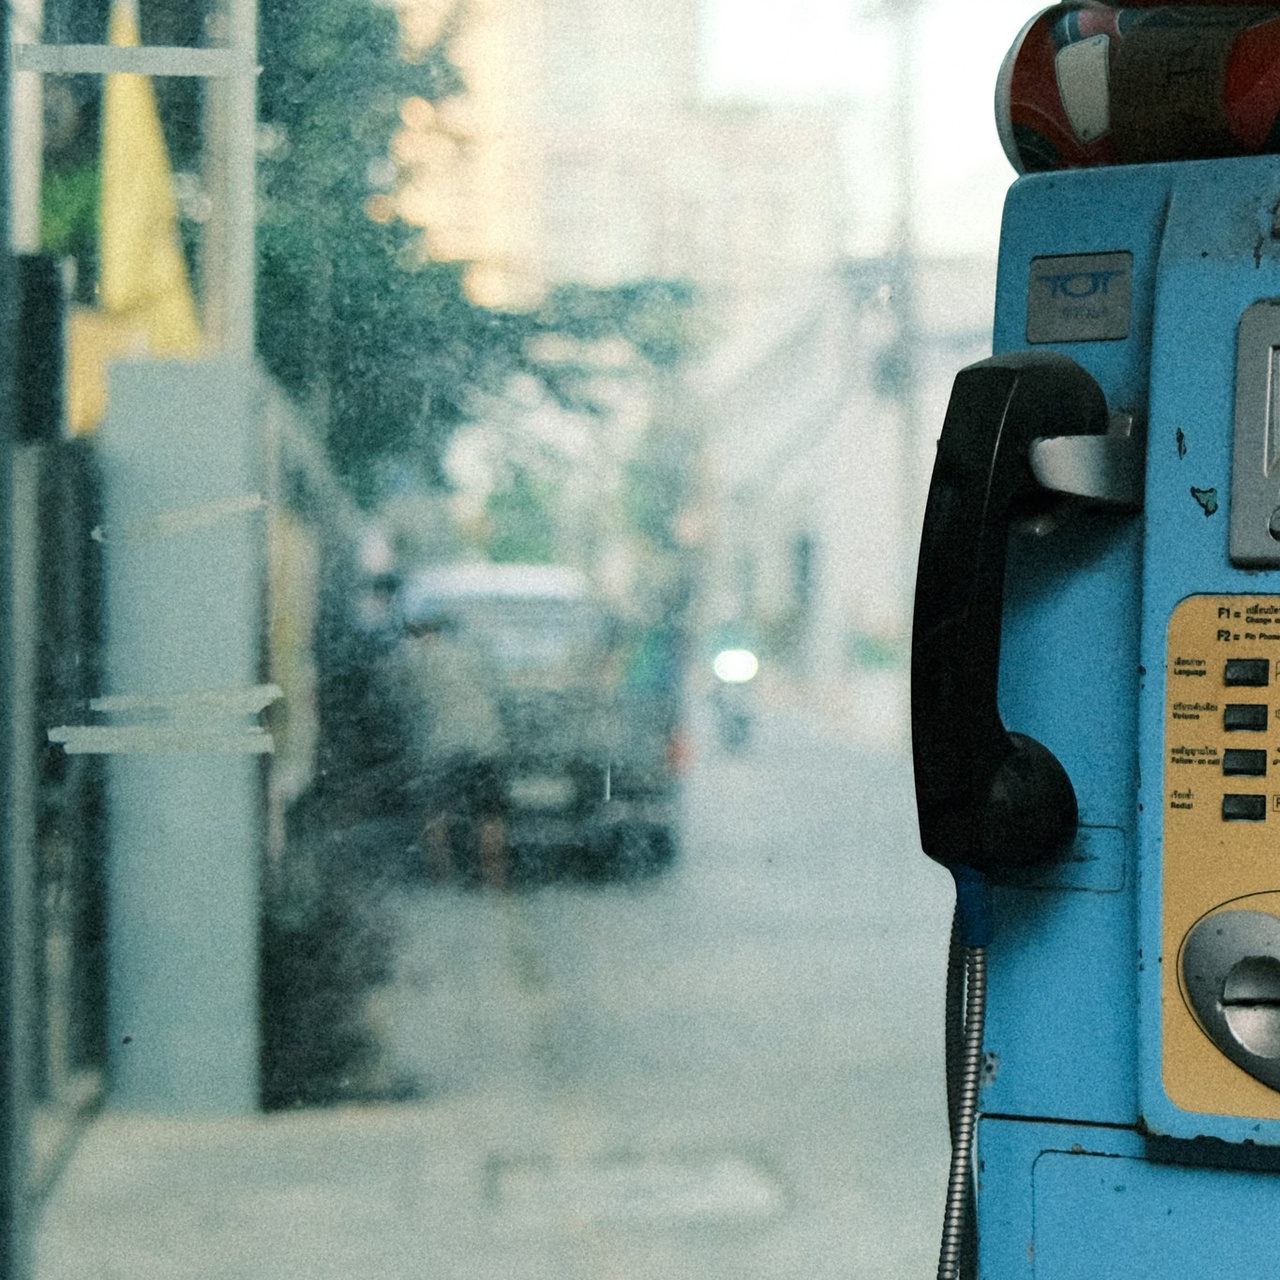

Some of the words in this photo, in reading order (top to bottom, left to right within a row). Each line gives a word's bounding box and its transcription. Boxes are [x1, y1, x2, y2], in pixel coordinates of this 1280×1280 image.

[1218, 607, 1230, 619] F1
[1217, 629, 1231, 641] F2
[1173, 668, 1207, 677] Language
[1172, 712, 1200, 720] Volume
[1170, 801, 1194, 809] Redial
